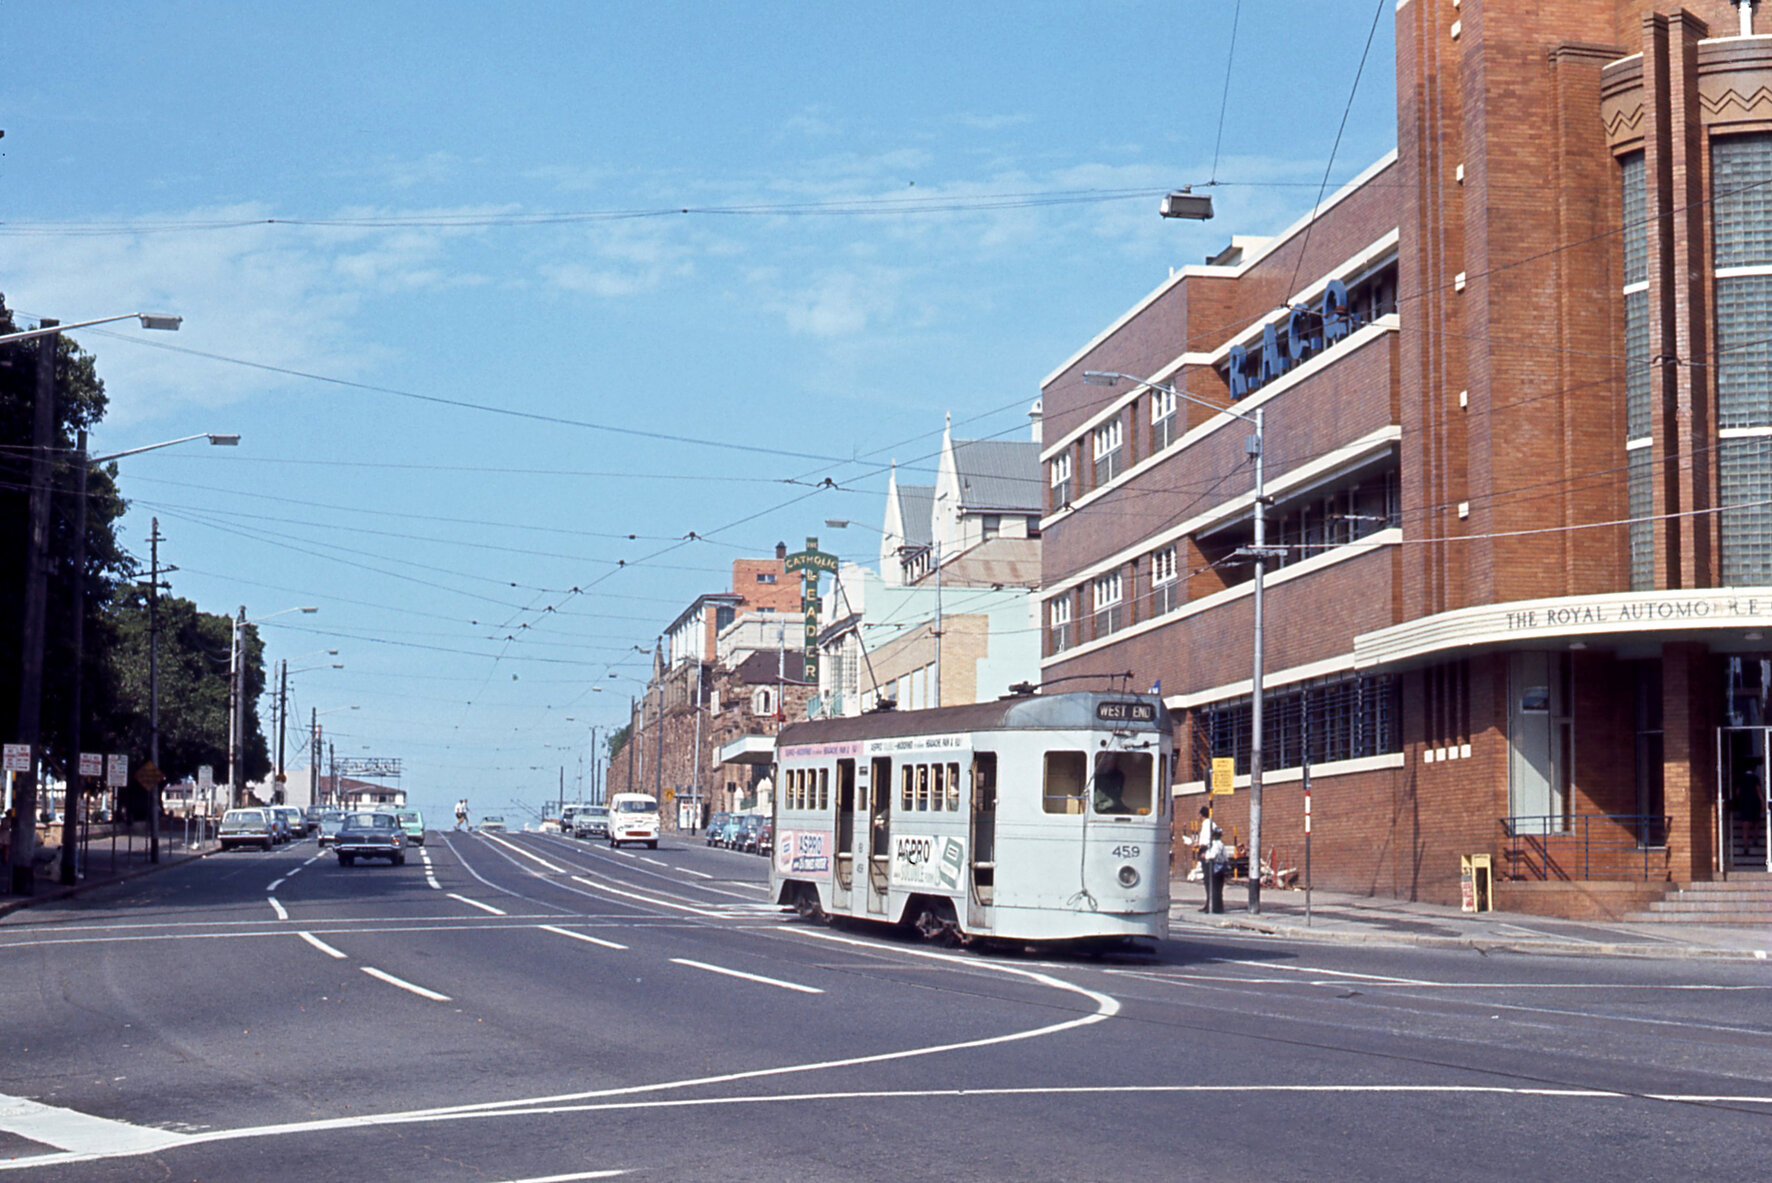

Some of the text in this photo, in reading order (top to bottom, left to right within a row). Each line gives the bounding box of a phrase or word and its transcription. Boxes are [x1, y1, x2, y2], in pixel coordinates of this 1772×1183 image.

[786, 555, 838, 569] CATHOLIC
[1506, 599, 1760, 629] THE ROYAL AUTOMOLE
[806, 569, 817, 677] LEADER
[1100, 704, 1151, 719] WEST END
[1112, 845, 1141, 859] 459
